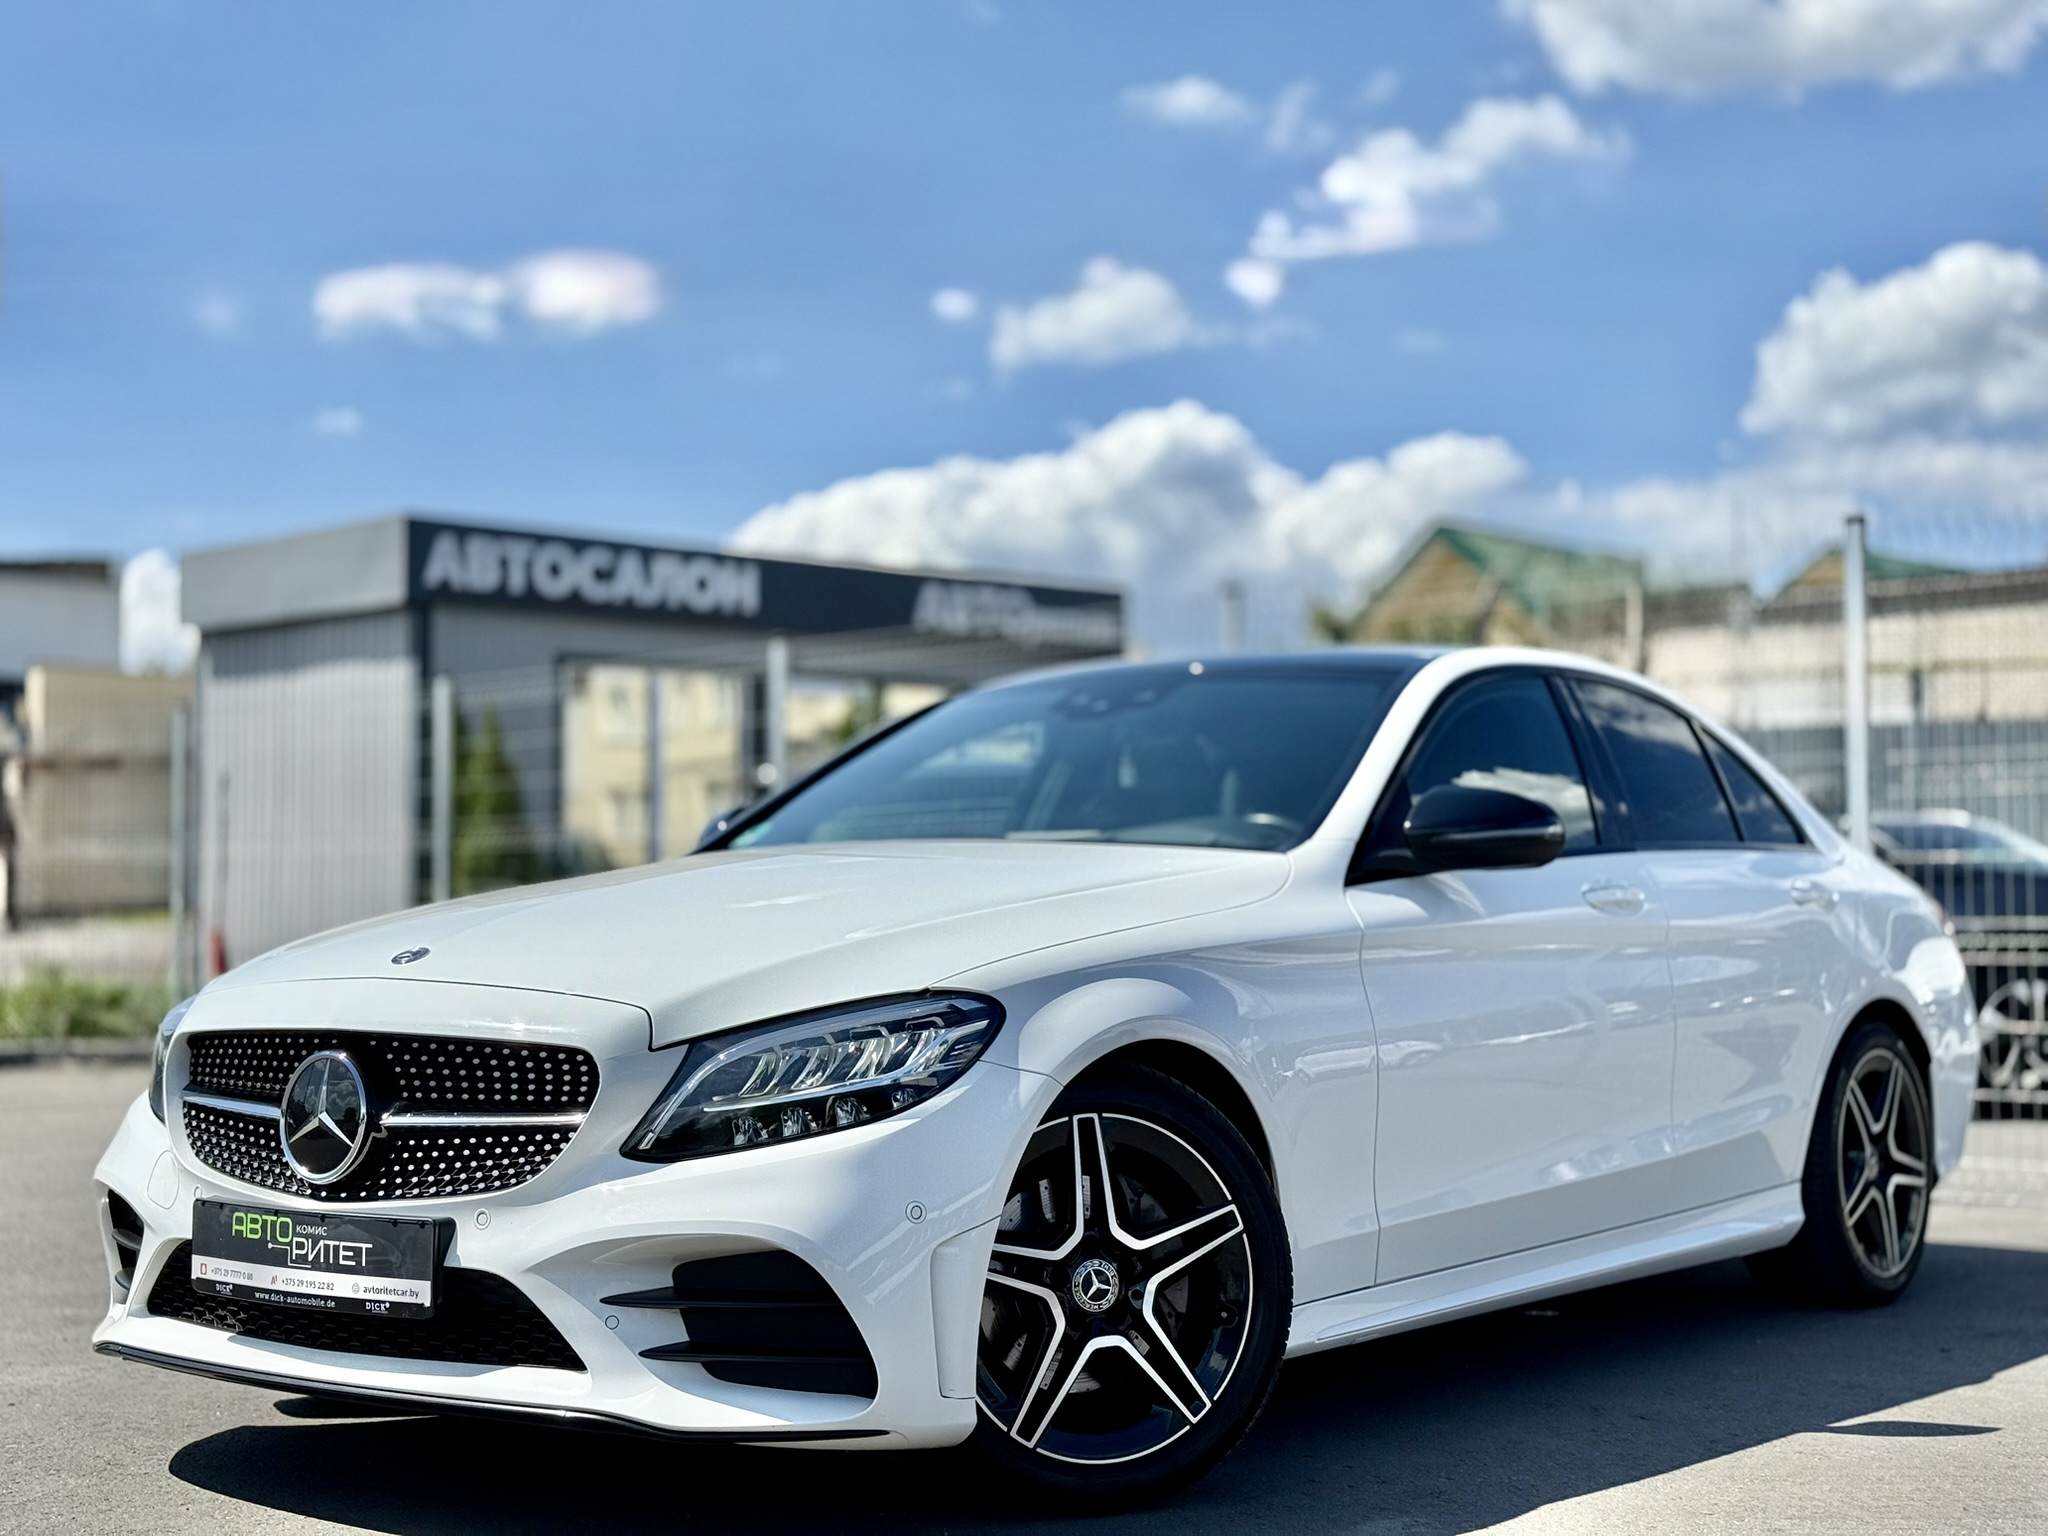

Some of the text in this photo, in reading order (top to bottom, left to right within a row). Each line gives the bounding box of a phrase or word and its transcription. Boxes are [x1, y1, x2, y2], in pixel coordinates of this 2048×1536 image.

[423, 529, 760, 617] АВТОСАЛОН
[232, 1211, 293, 1243] АВТО
[296, 1224, 328, 1236] КОМИС
[292, 1237, 373, 1267] РИТЕТ
[211, 1267, 223, 1276] +375
[281, 1277, 335, 1291] +375 29 195 22 82
[254, 1290, 336, 1308] www.dick-automobile.de
[363, 1285, 420, 1300] avtoritetcar.by
